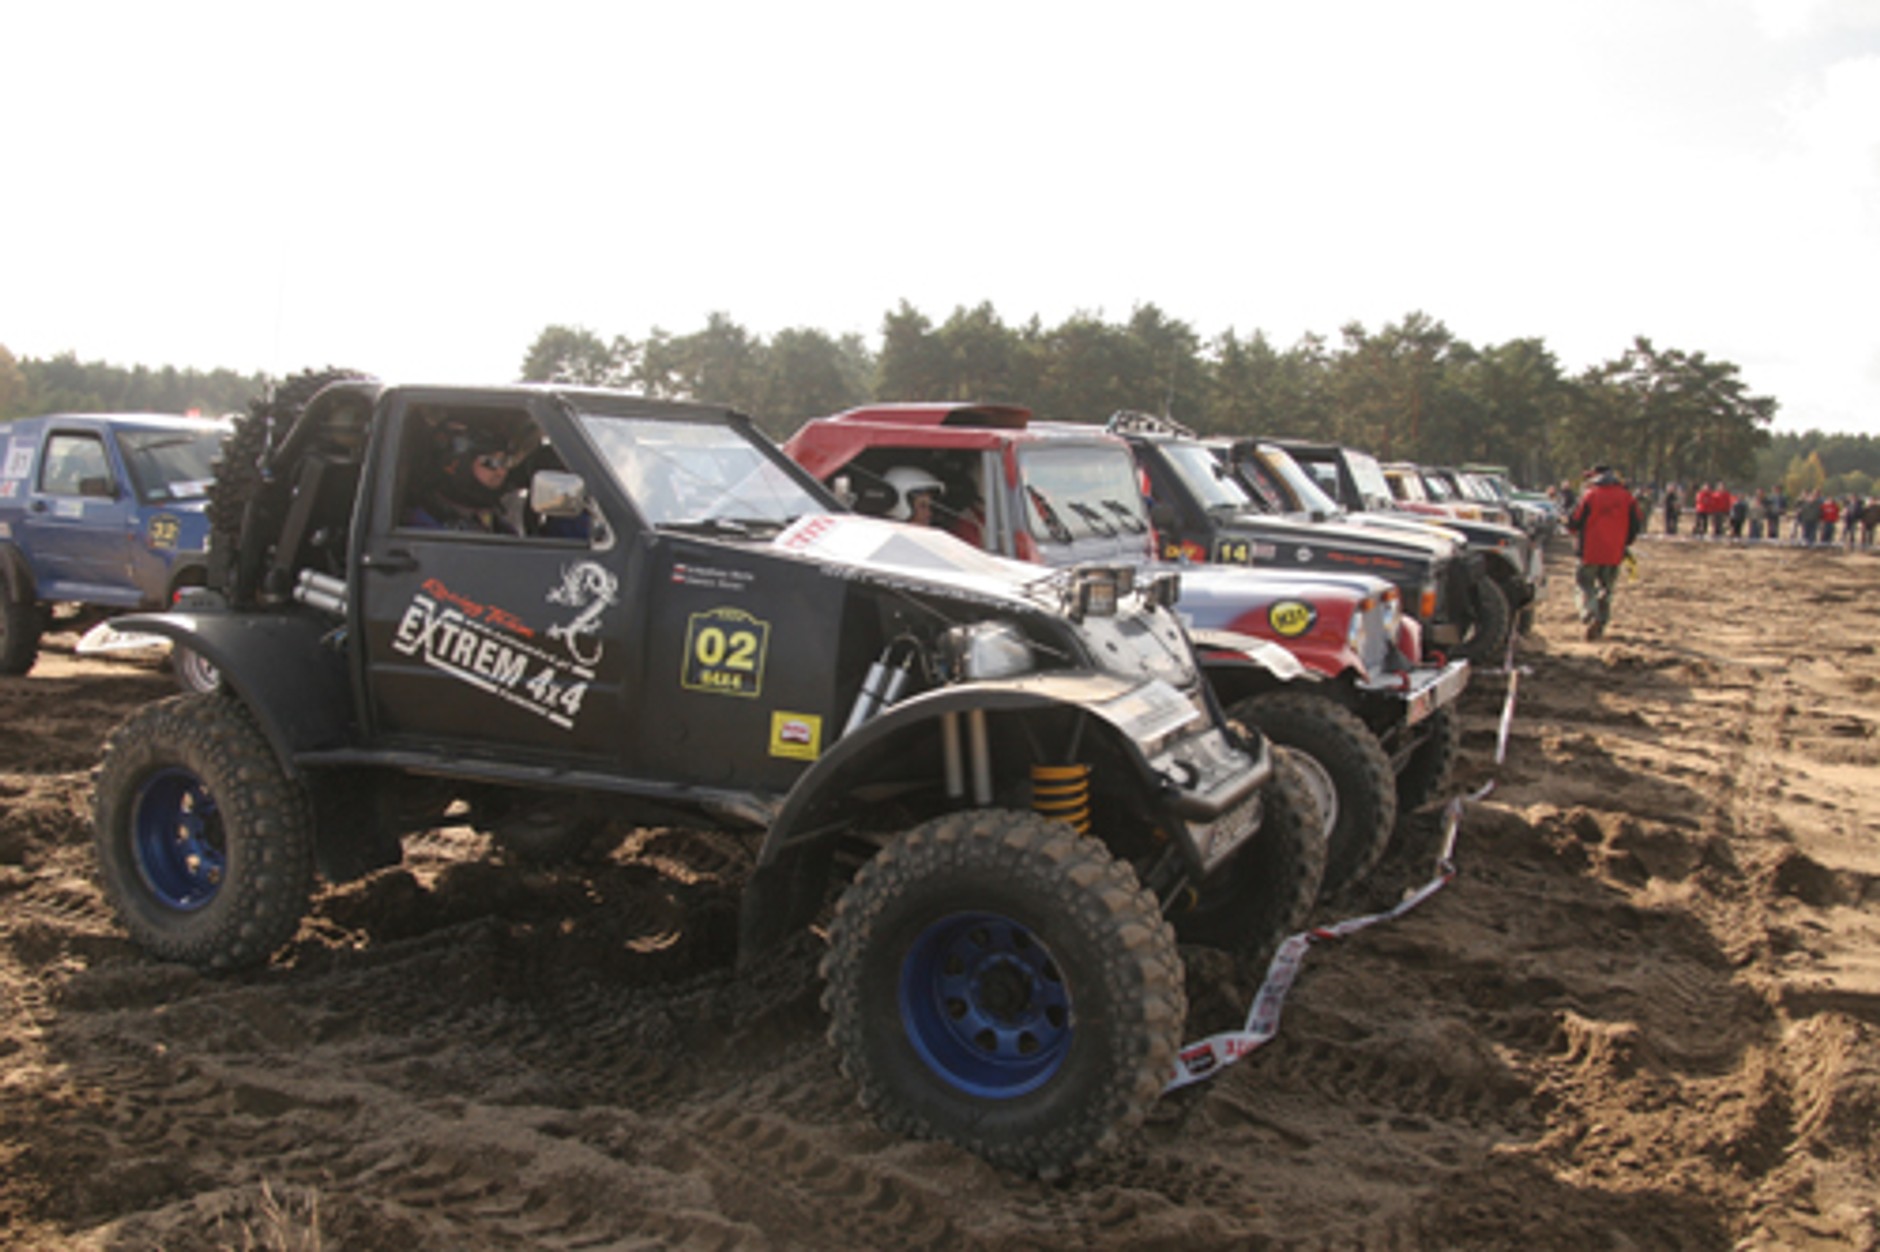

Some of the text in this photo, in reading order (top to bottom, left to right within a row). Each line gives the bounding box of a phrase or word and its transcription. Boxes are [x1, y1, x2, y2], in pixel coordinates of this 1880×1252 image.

[1221, 544, 1247, 561] 14
[394, 594, 588, 716] EXTREM 4x4
[695, 626, 758, 671] 02
